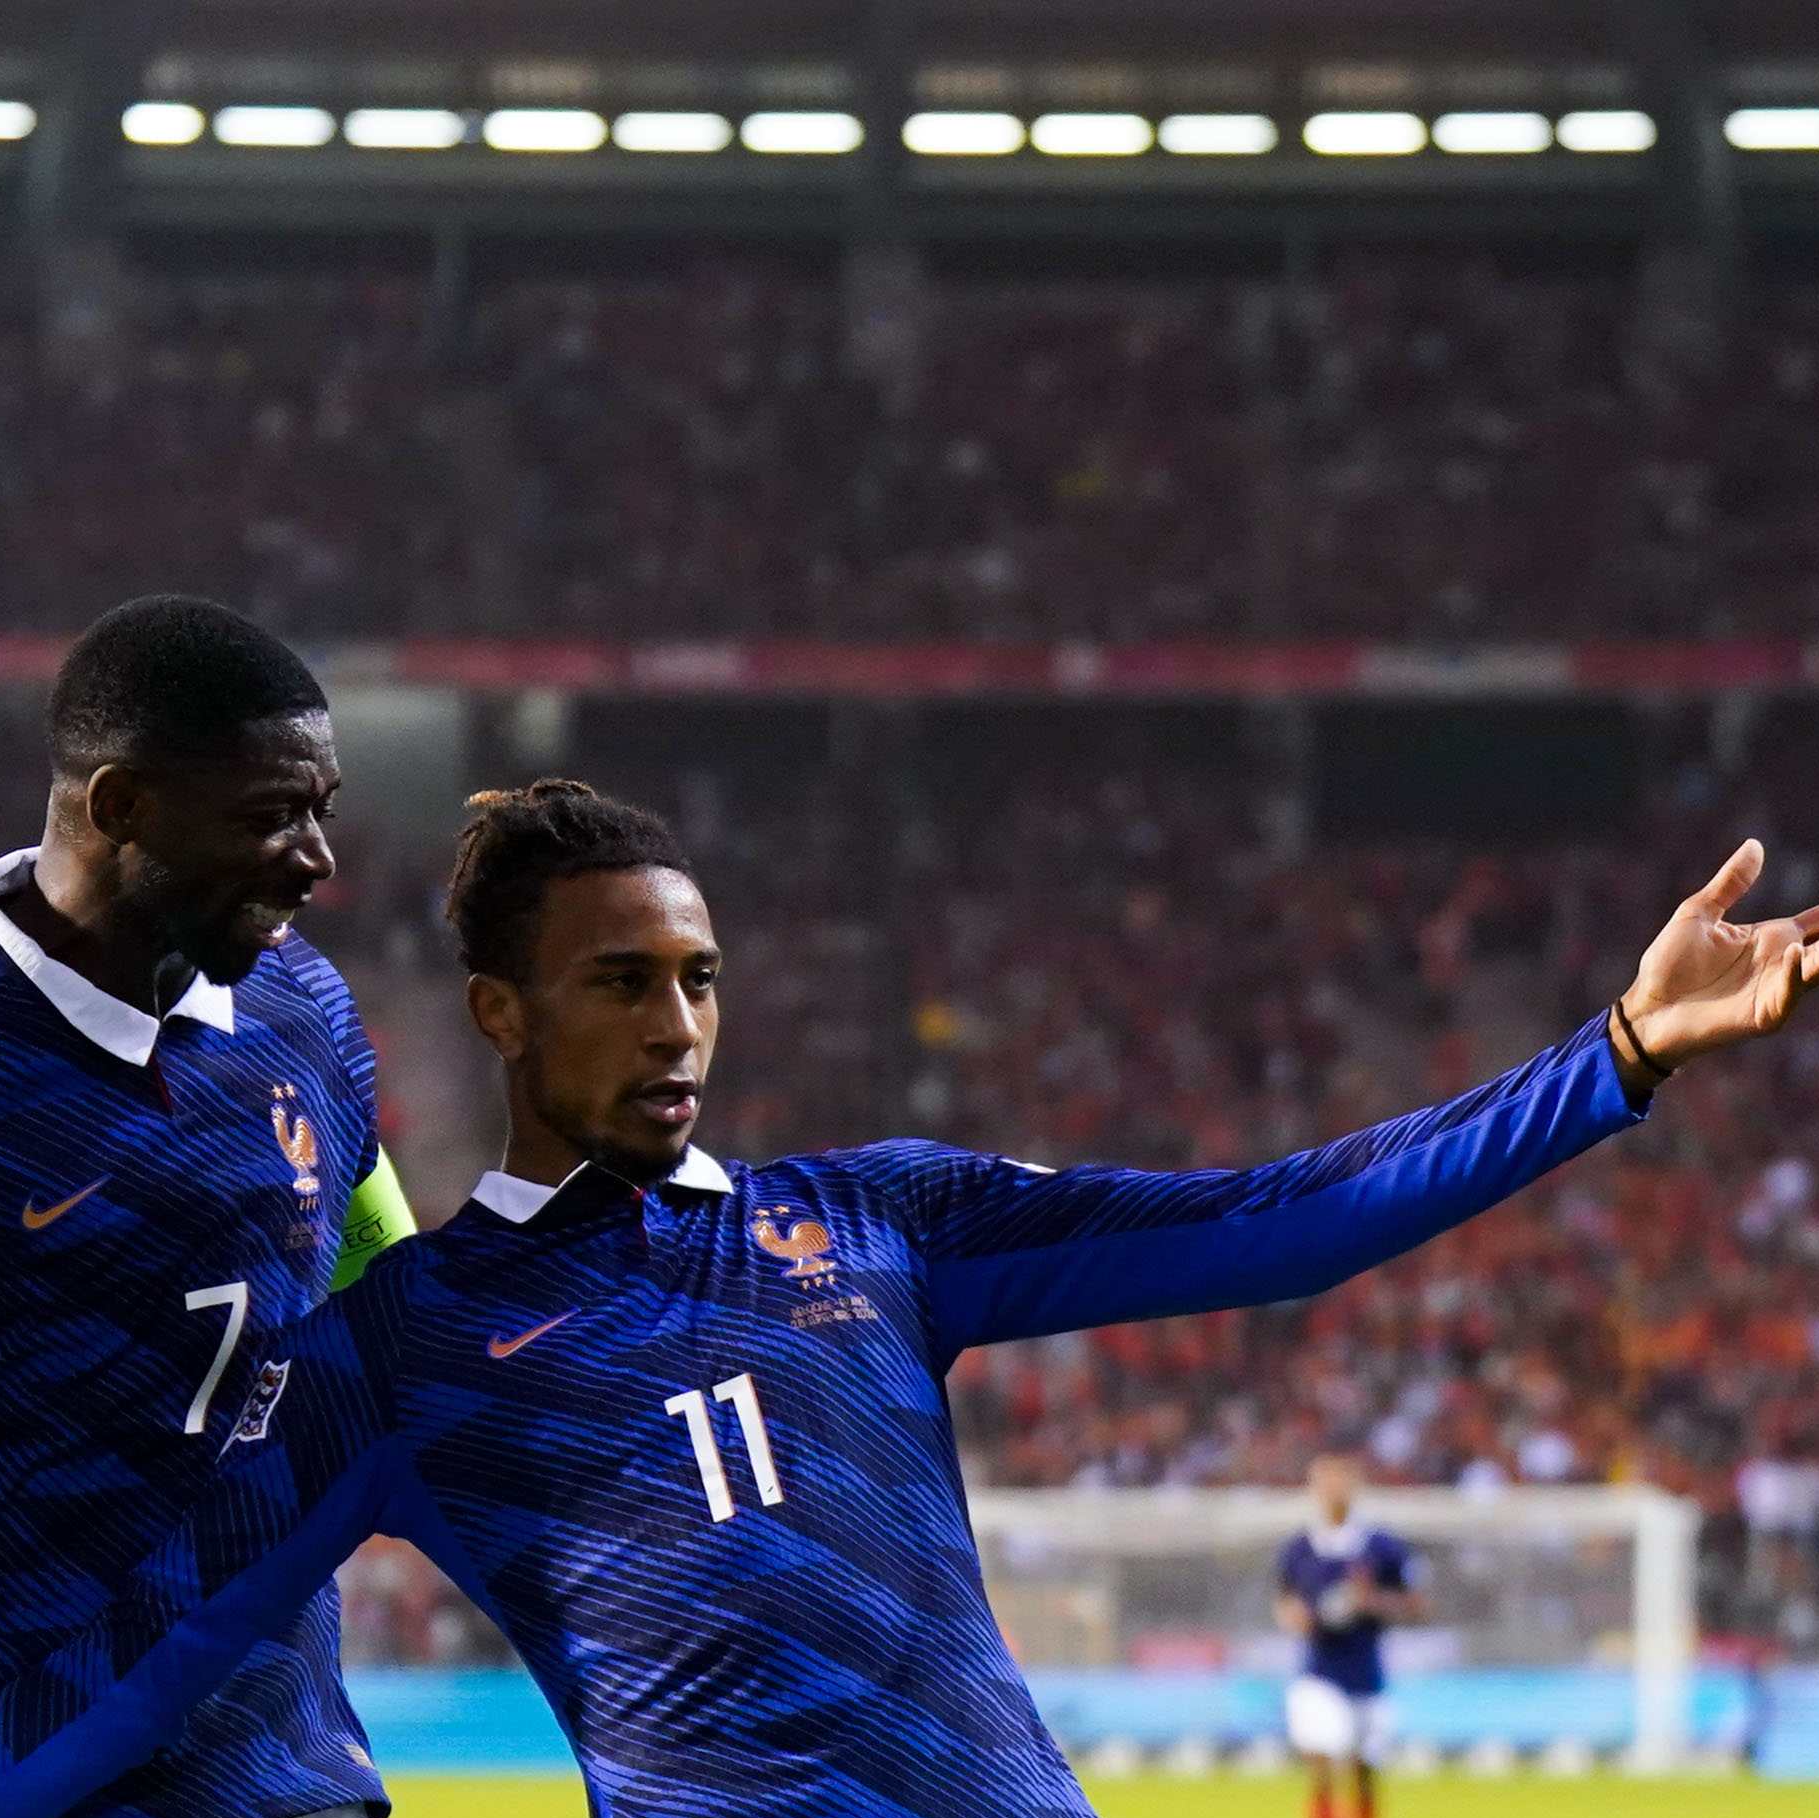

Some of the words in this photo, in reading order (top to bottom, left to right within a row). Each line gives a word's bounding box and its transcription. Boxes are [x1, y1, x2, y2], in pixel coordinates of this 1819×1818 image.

[344, 1215, 384, 1249] ECT
[184, 1281, 248, 1434] 7
[664, 1372, 785, 1524] 11
